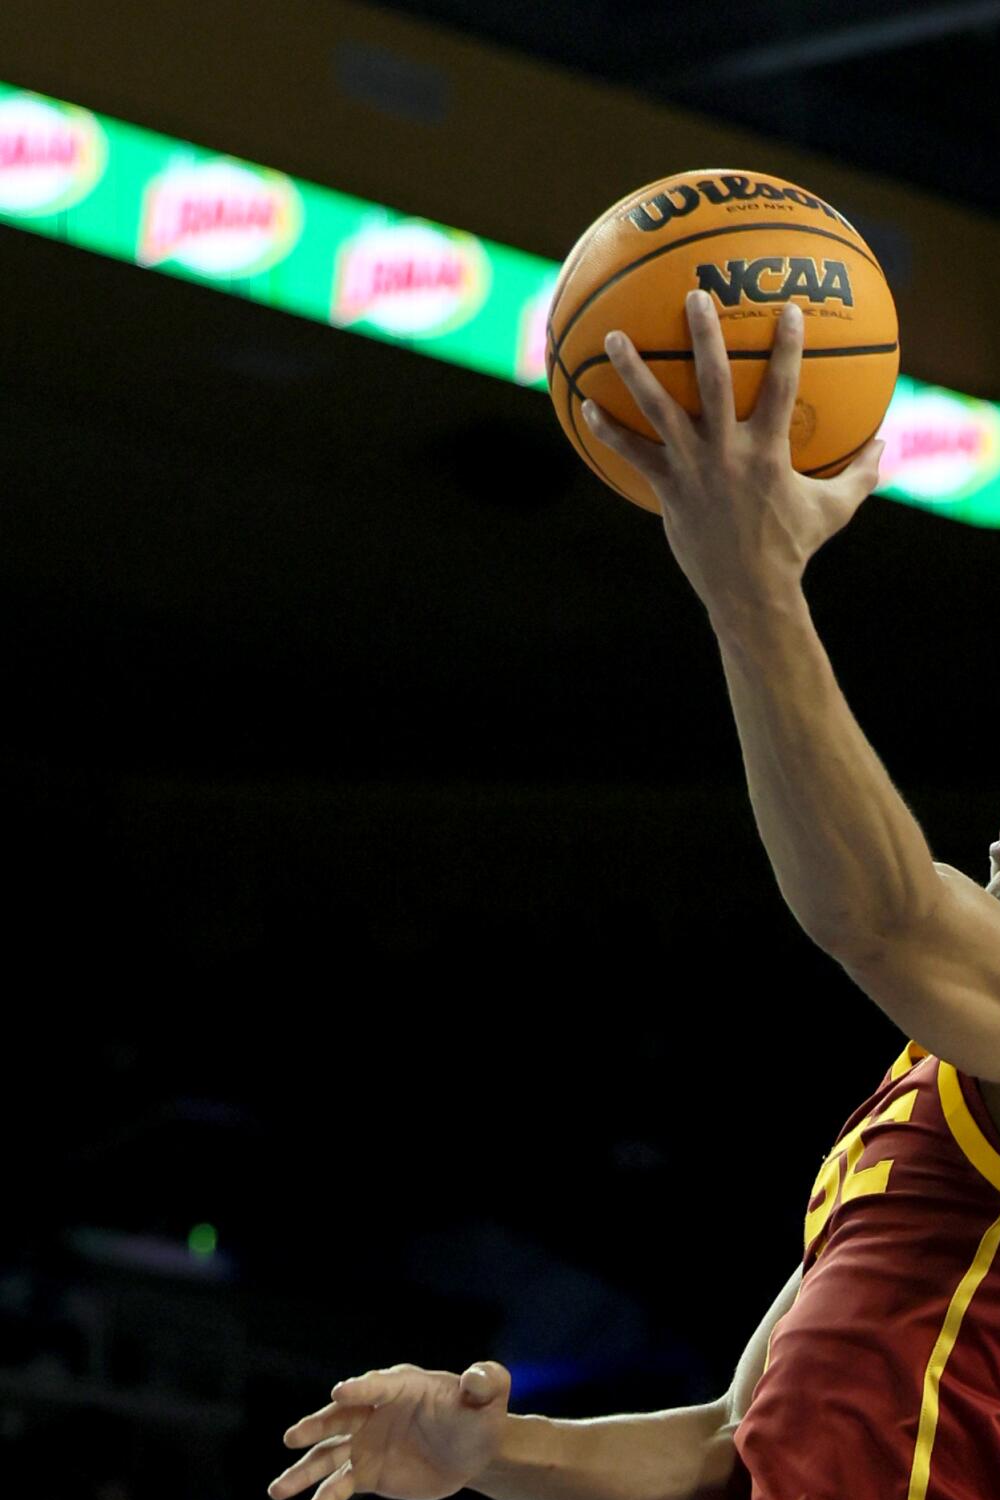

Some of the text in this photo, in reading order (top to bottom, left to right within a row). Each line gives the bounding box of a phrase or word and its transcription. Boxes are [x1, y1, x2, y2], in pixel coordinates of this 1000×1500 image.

[726, 202, 794, 213] EVO NXT
[696, 257, 854, 308] NCAA
